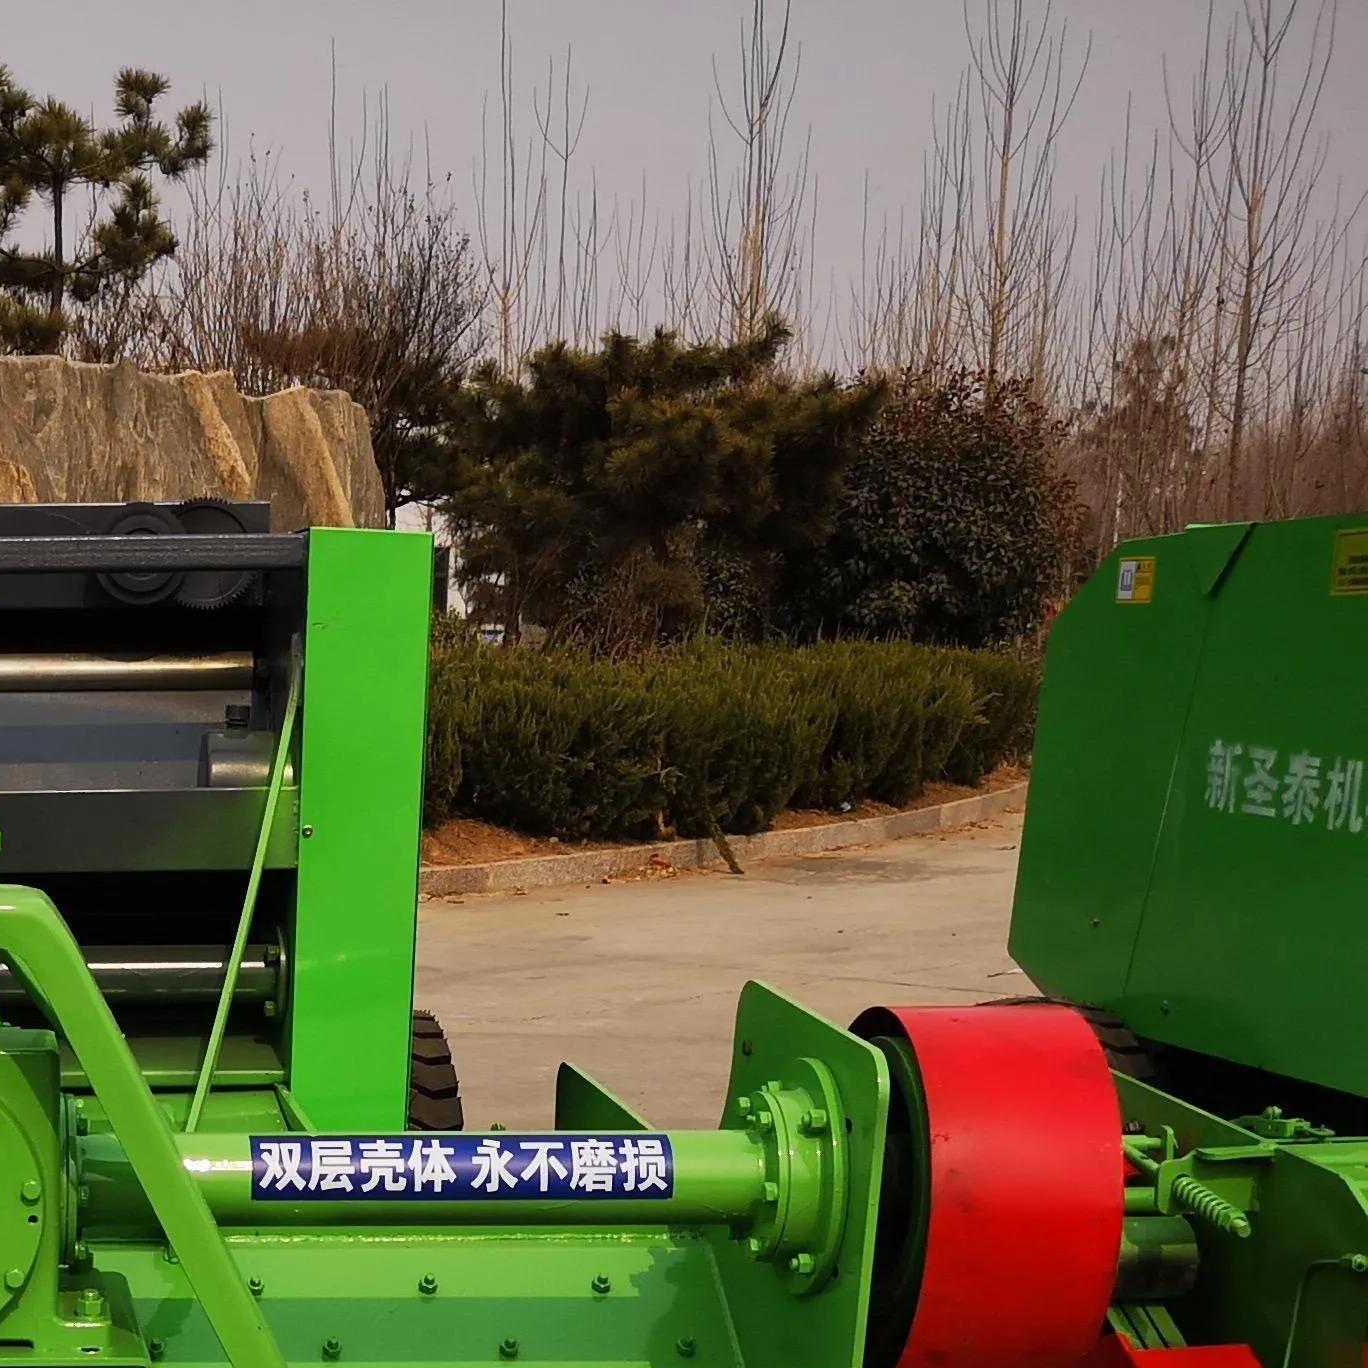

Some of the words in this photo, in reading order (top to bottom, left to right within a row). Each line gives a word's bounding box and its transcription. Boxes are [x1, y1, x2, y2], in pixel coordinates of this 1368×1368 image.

[1204, 738, 1368, 833] 新圣泰机
[259, 1139, 455, 1192] 双层壳体
[471, 1139, 668, 1192] 永不磨损
